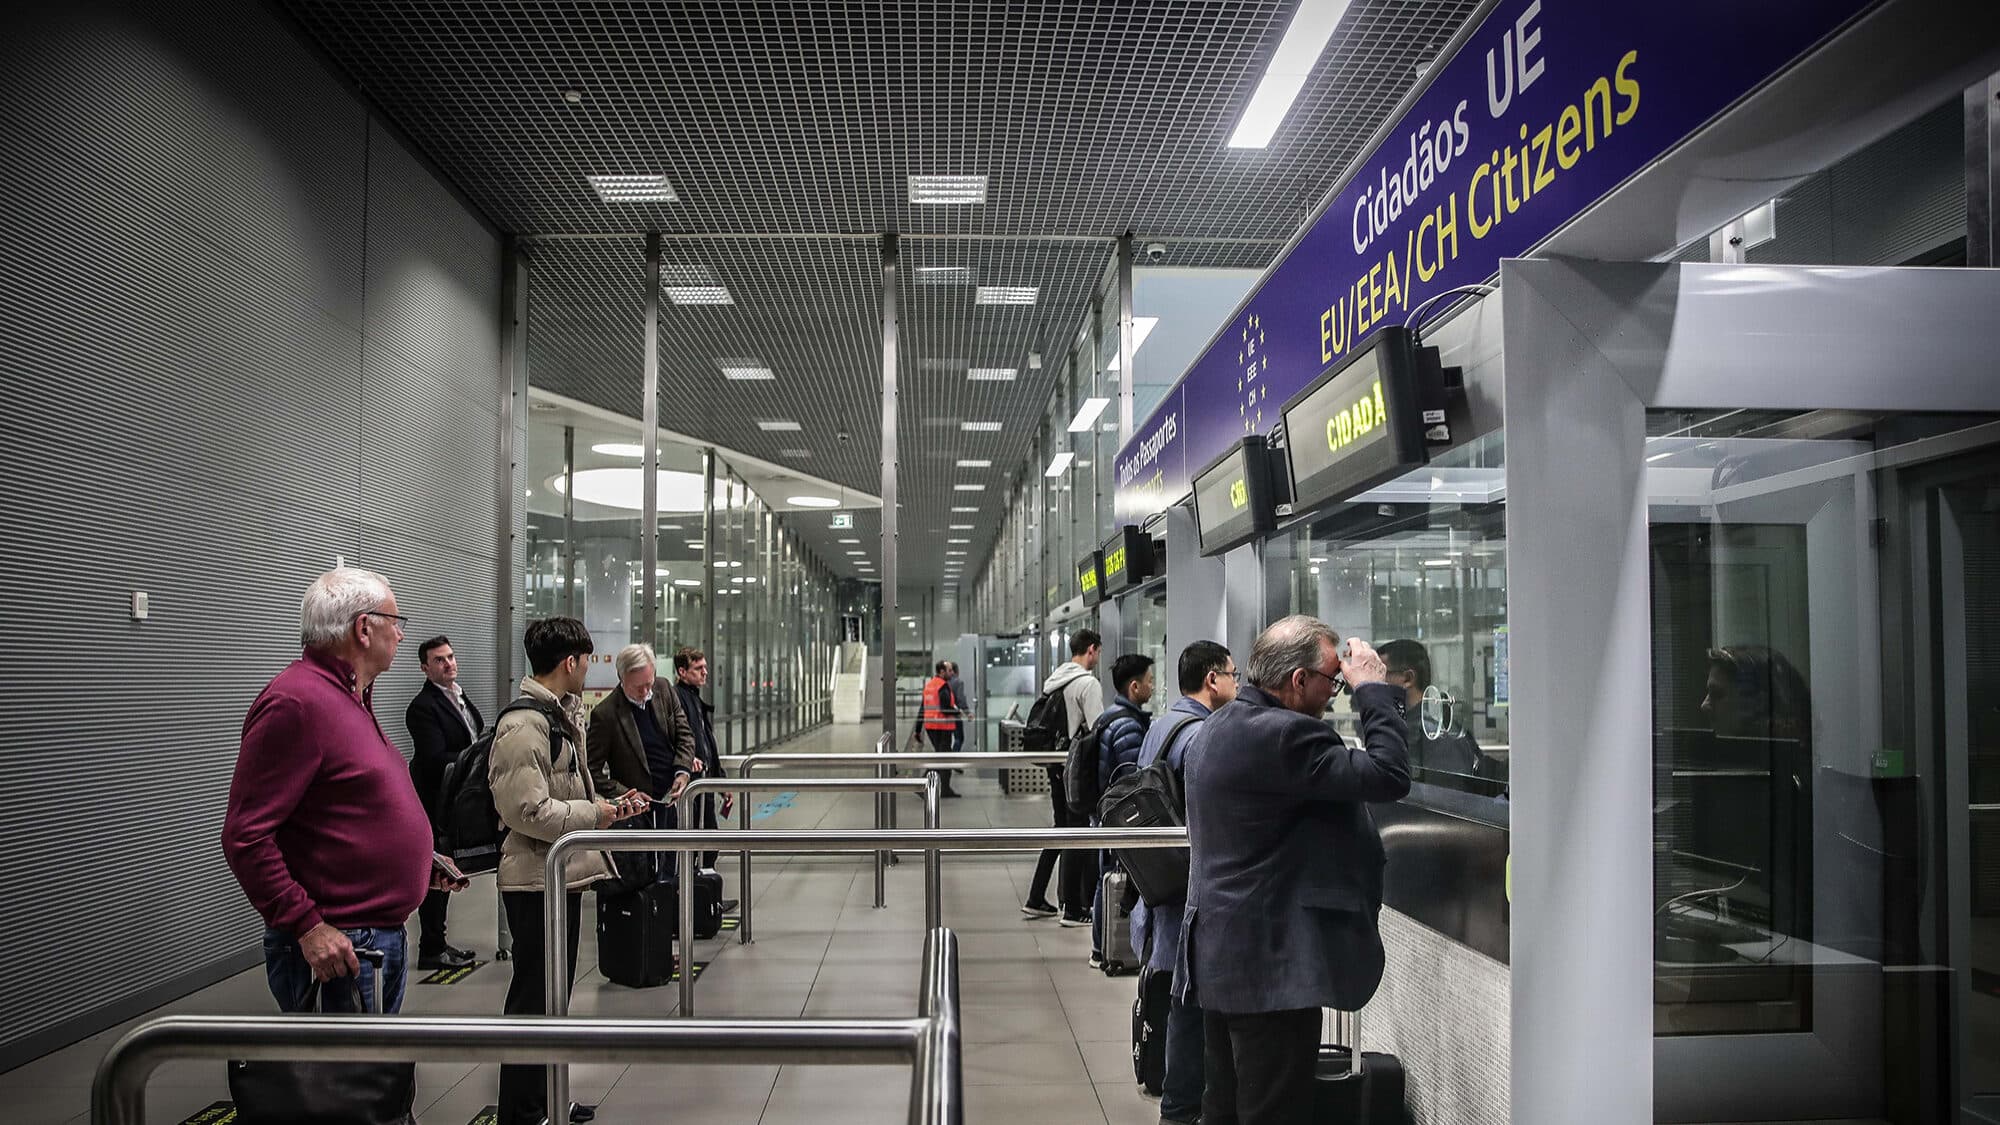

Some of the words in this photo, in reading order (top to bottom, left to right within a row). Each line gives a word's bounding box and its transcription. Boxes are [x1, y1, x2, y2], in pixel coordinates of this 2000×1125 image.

[1352, 98, 1470, 255] Cidadãos
[1486, 0, 1545, 119] UE
[1320, 191, 1459, 365] EU/EEA/CH
[1467, 49, 1641, 240] Citizens
[1246, 338, 1256, 358] UE
[1246, 360, 1258, 383] EEE
[1247, 390, 1258, 407] CH
[1326, 381, 1387, 452] CIDADA
[1119, 456, 1133, 489] Todos
[1133, 452, 1140, 474] os
[1140, 411, 1177, 468] Passaportes
